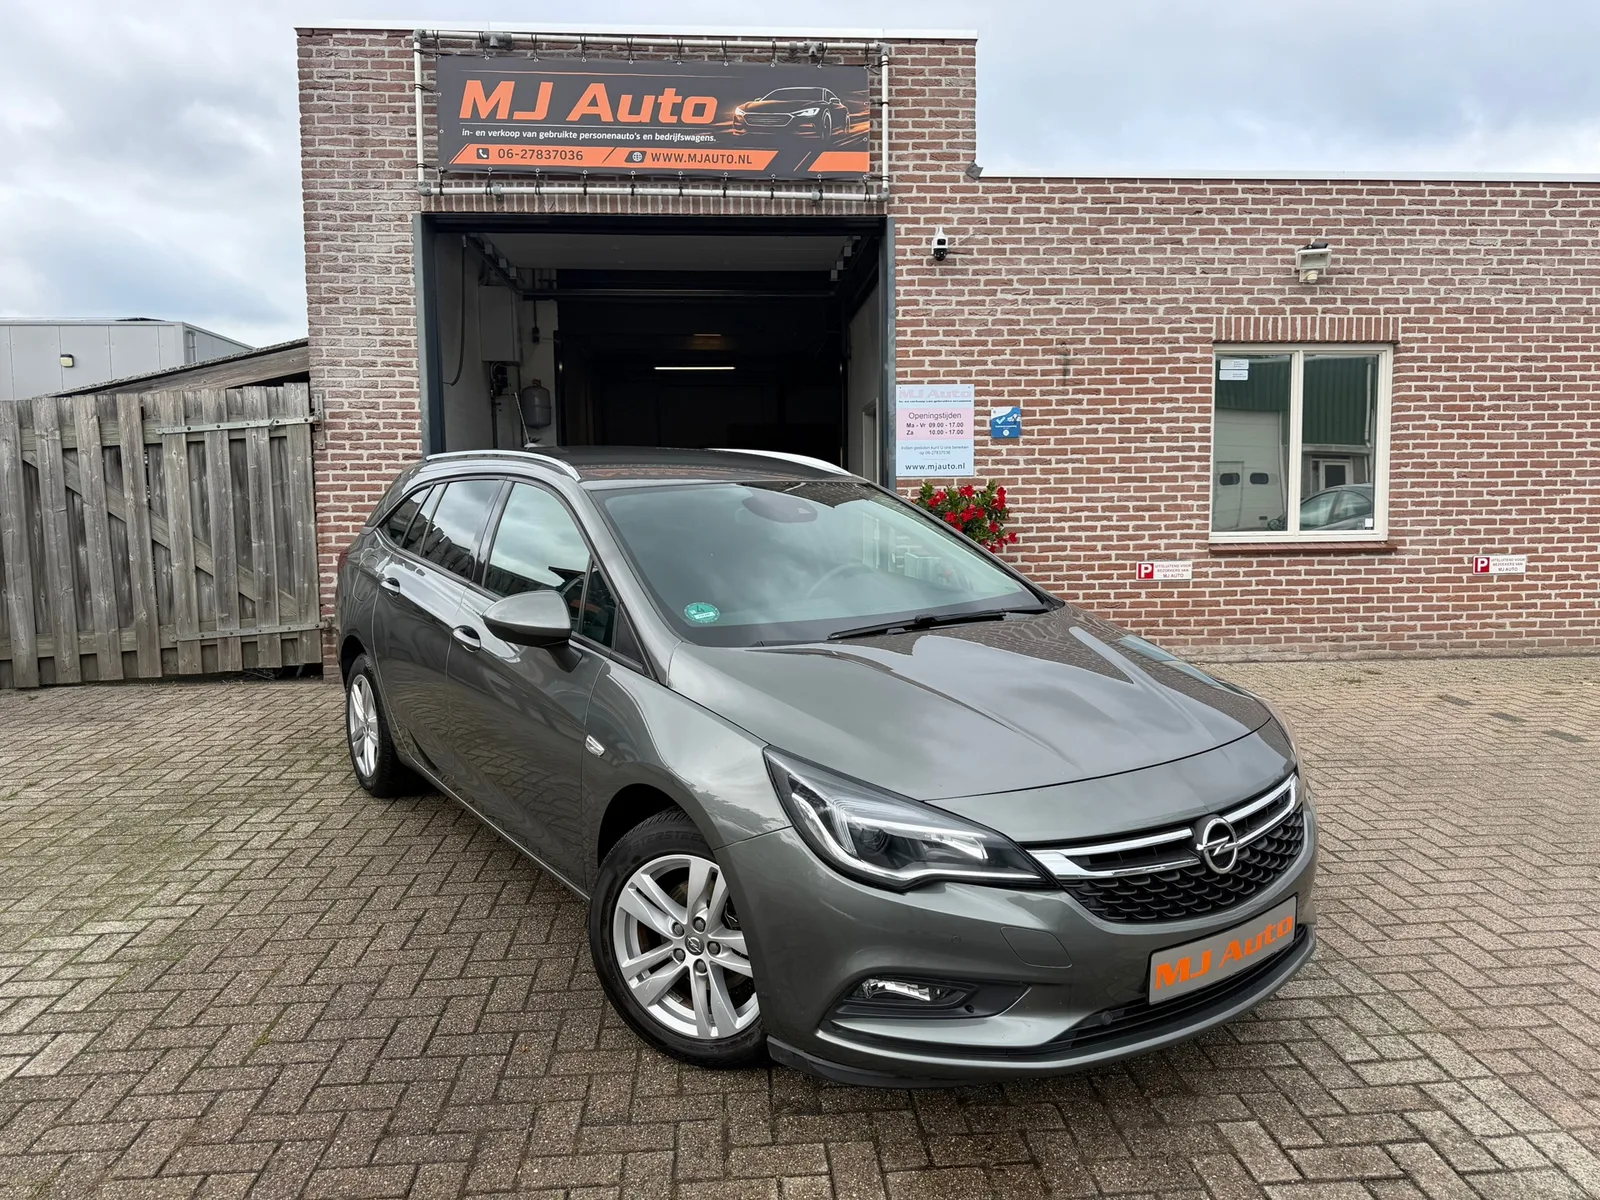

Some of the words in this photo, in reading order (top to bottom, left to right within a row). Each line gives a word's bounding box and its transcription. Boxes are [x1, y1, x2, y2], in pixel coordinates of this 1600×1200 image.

[459, 80, 554, 120] MJ
[565, 83, 718, 124] Auto
[462, 128, 473, 137] in-
[475, 129, 486, 137] en
[487, 129, 521, 139] verkoop
[522, 130, 537, 138] van
[539, 130, 578, 140] gebruikte
[579, 131, 641, 141] personenauto's
[655, 132, 717, 143] bedrijfswagens.
[497, 148, 584, 161] 06-27837036
[651, 152, 752, 165] WWW.MJAUTO.NL
[899, 389, 924, 399] MJ
[927, 388, 972, 399] Auto
[908, 412, 962, 421] Openingstijden
[905, 462, 966, 472] www.mjauto.nl
[1141, 564, 1153, 578] P
[1478, 558, 1488, 572] P
[1155, 950, 1212, 990] MJ
[1218, 915, 1294, 969] Auto
